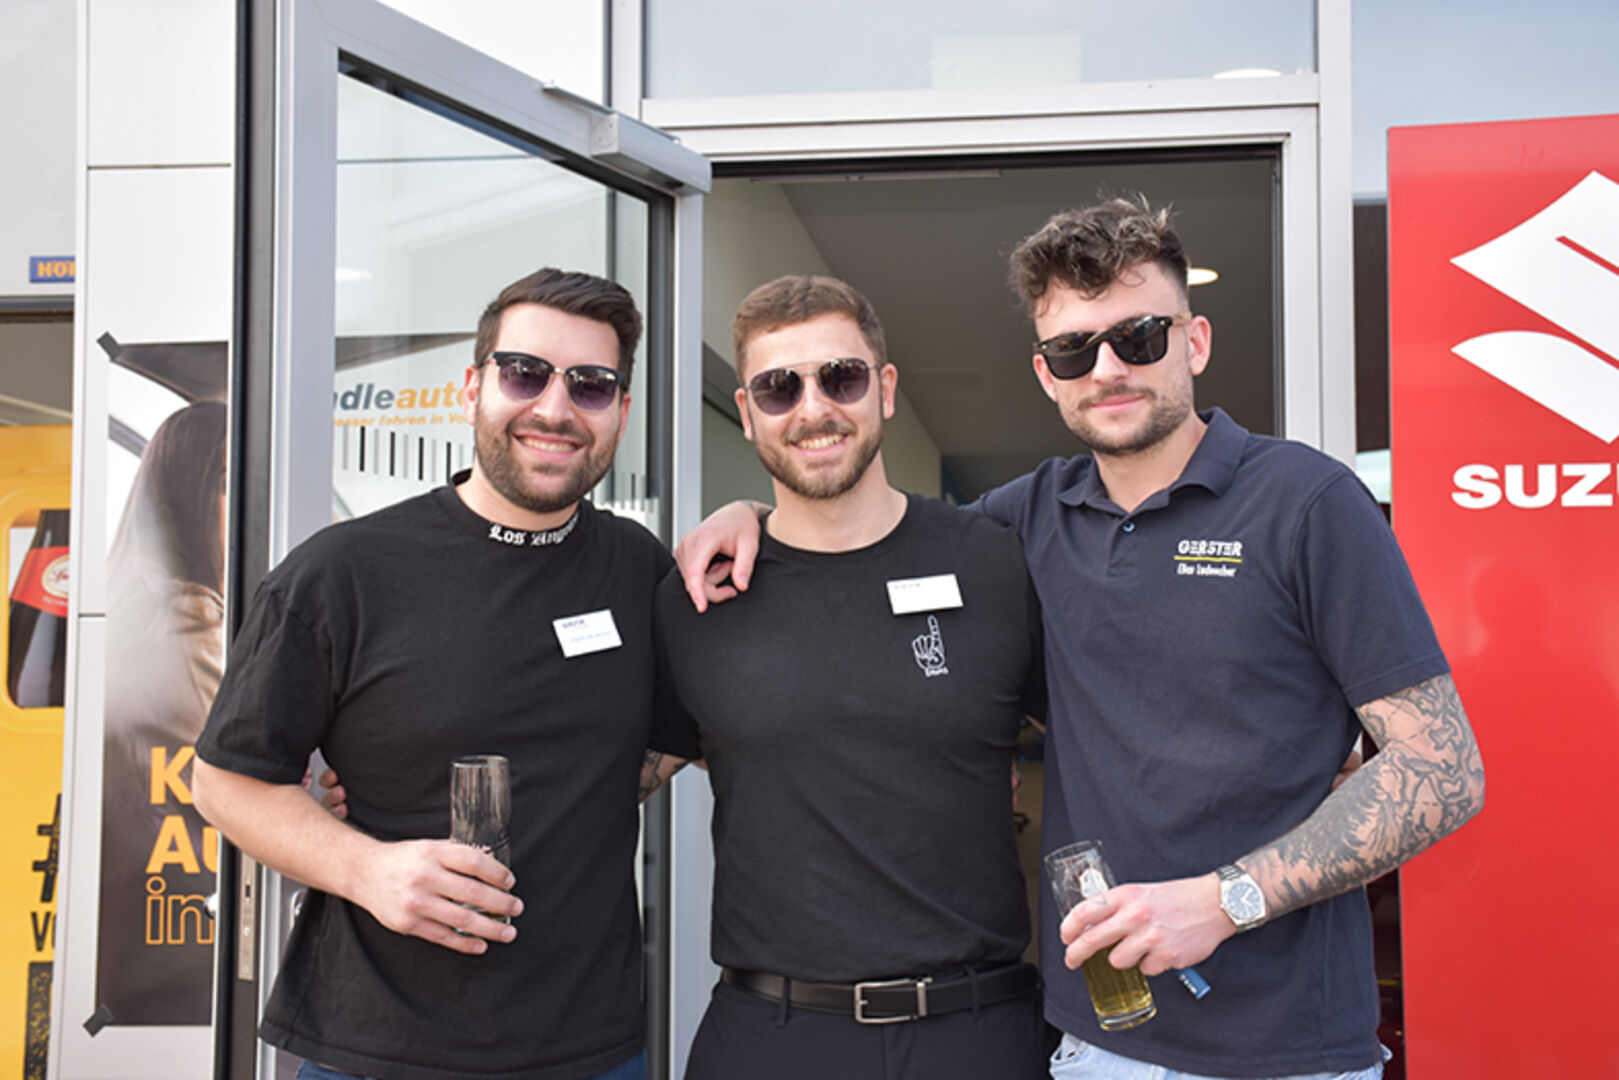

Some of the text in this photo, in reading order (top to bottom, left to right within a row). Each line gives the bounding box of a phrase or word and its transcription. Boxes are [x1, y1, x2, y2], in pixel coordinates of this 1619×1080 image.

[334, 416, 376, 428] esser
[379, 413, 427, 427] fahren
[430, 411, 445, 425] in
[1451, 463, 1619, 509] SUZ
[489, 523, 527, 546] Los
[1178, 539, 1243, 557] GERSTER
